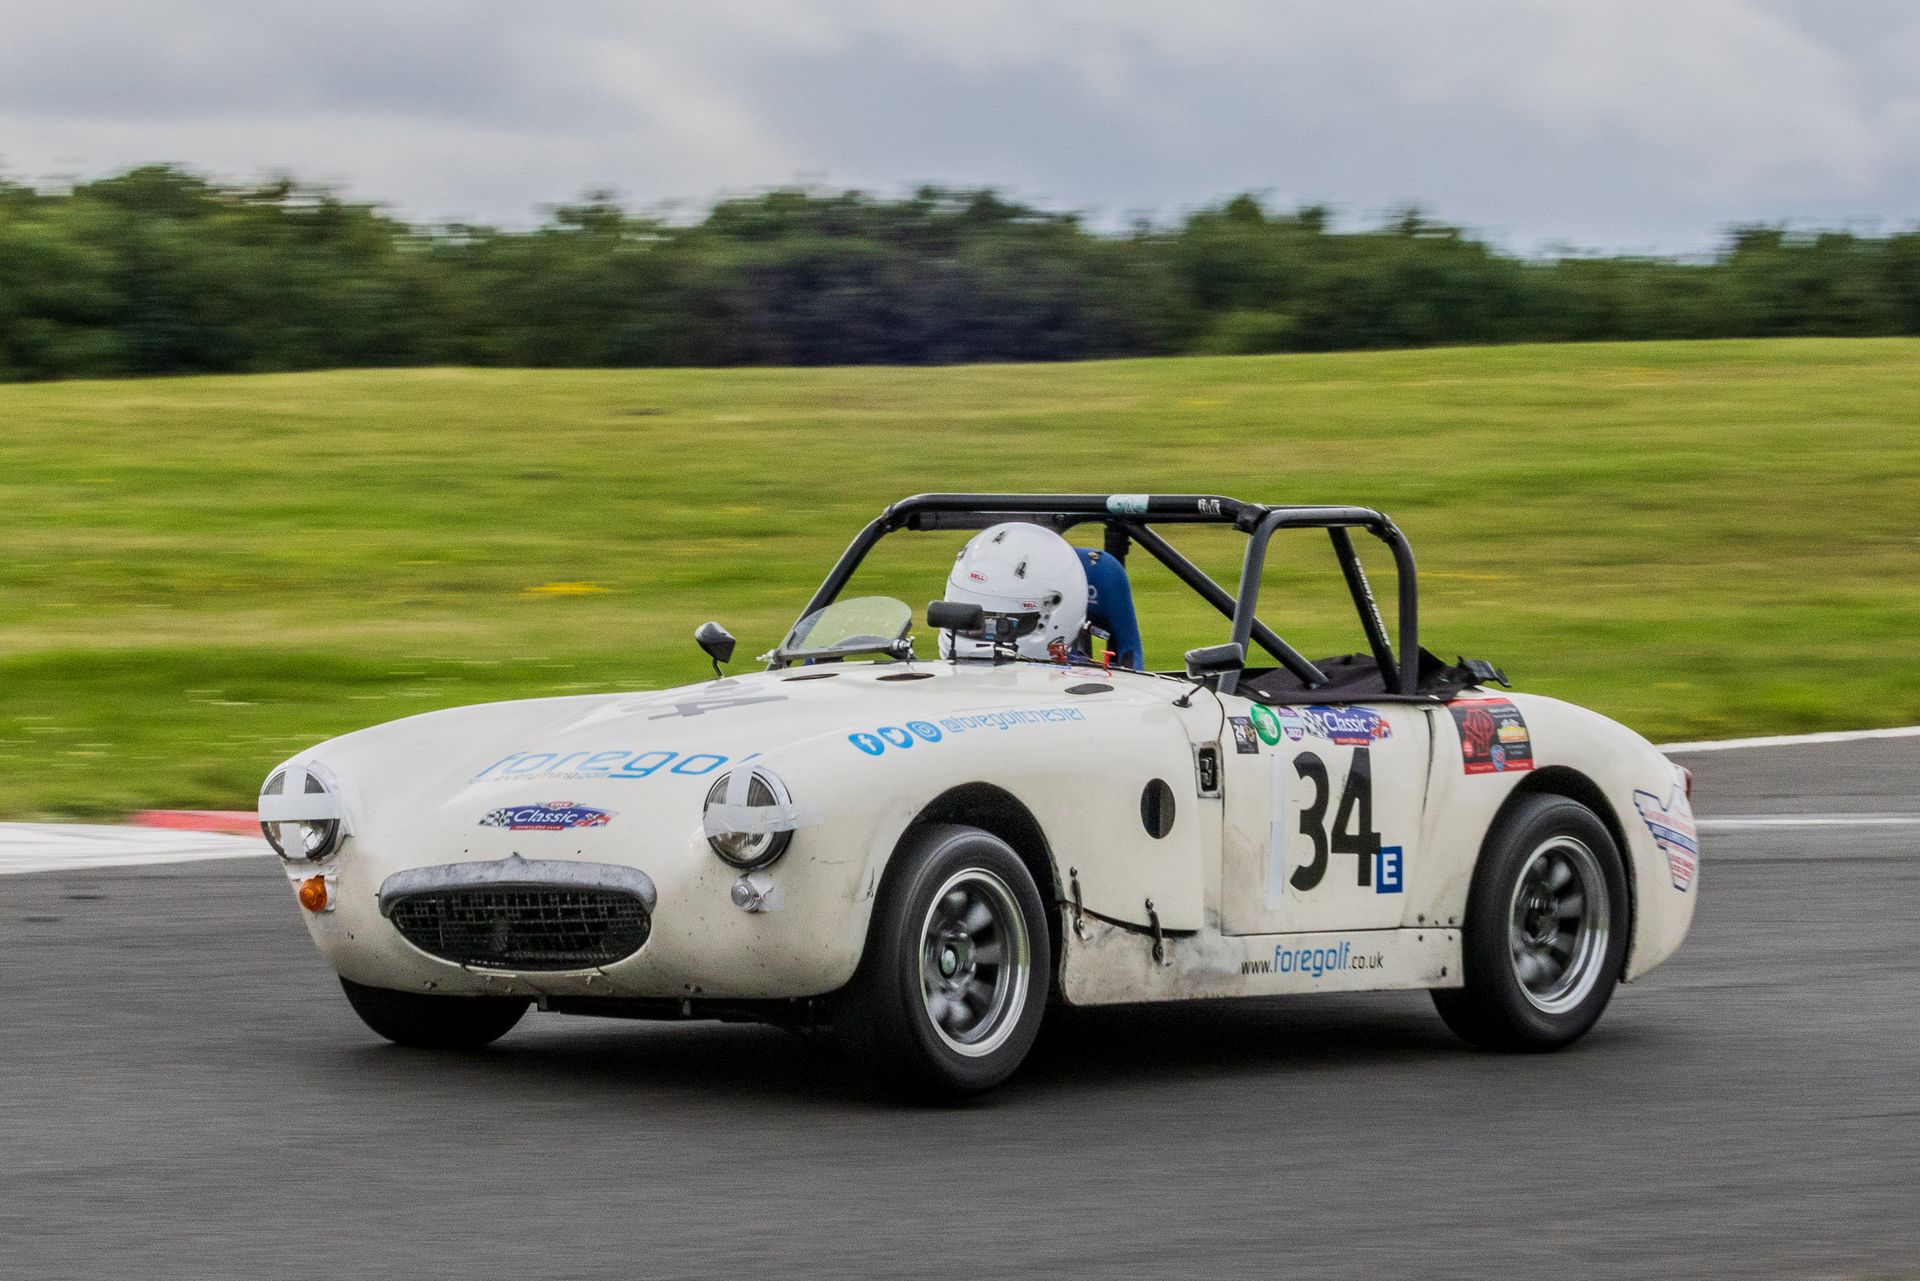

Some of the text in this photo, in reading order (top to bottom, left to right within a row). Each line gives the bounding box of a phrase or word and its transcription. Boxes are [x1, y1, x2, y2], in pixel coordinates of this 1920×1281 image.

[1022, 601, 1038, 609] BELL
[1323, 711, 1370, 733] Classic
[512, 808, 579, 823] Classic
[1289, 746, 1381, 892] 34
[1382, 852, 1398, 885] E
[1241, 940, 1384, 978] www.foregolf.co.uk
